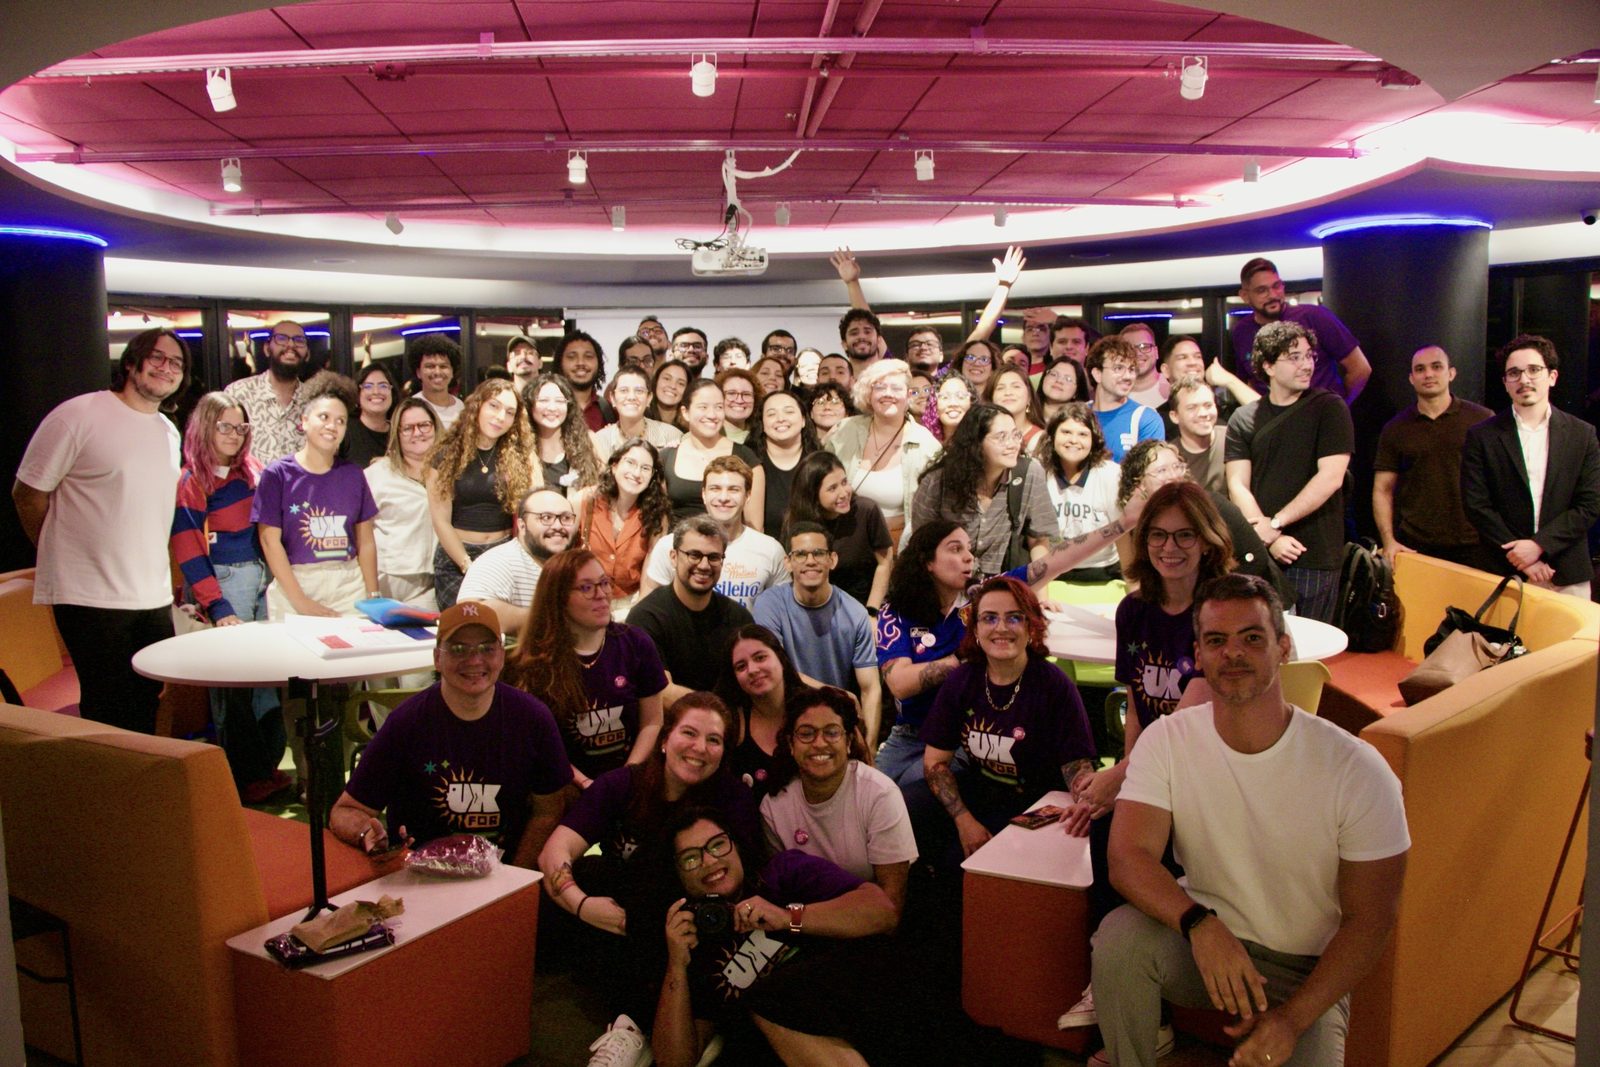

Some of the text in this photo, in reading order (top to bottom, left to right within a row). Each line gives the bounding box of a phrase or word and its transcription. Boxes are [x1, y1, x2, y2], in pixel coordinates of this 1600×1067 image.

[462, 604, 479, 616] NY
[446, 783, 502, 813] UX
[467, 815, 499, 826] FOR
